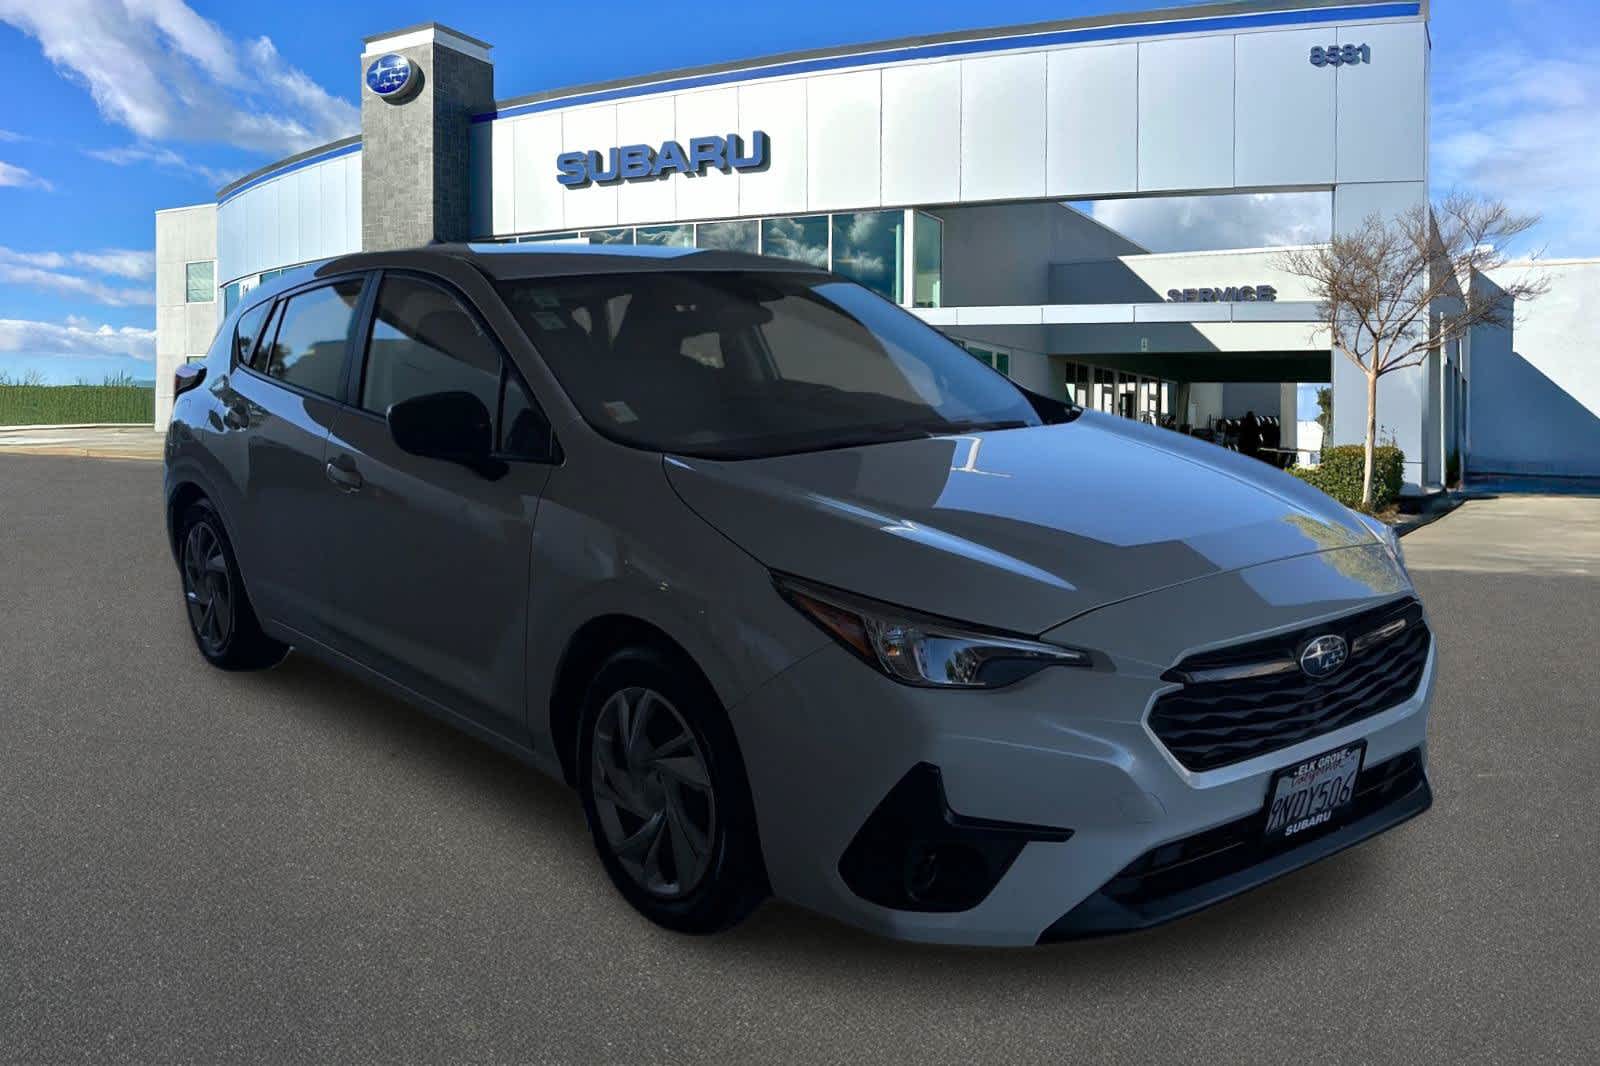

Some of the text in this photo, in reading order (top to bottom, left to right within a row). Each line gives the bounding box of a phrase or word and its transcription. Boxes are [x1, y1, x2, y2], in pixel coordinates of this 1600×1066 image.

[556, 130, 771, 190] SUBARU
[1166, 285, 1277, 303] SERVICE
[1298, 760, 1317, 776] ELK
[1285, 810, 1332, 836] SUBARU
